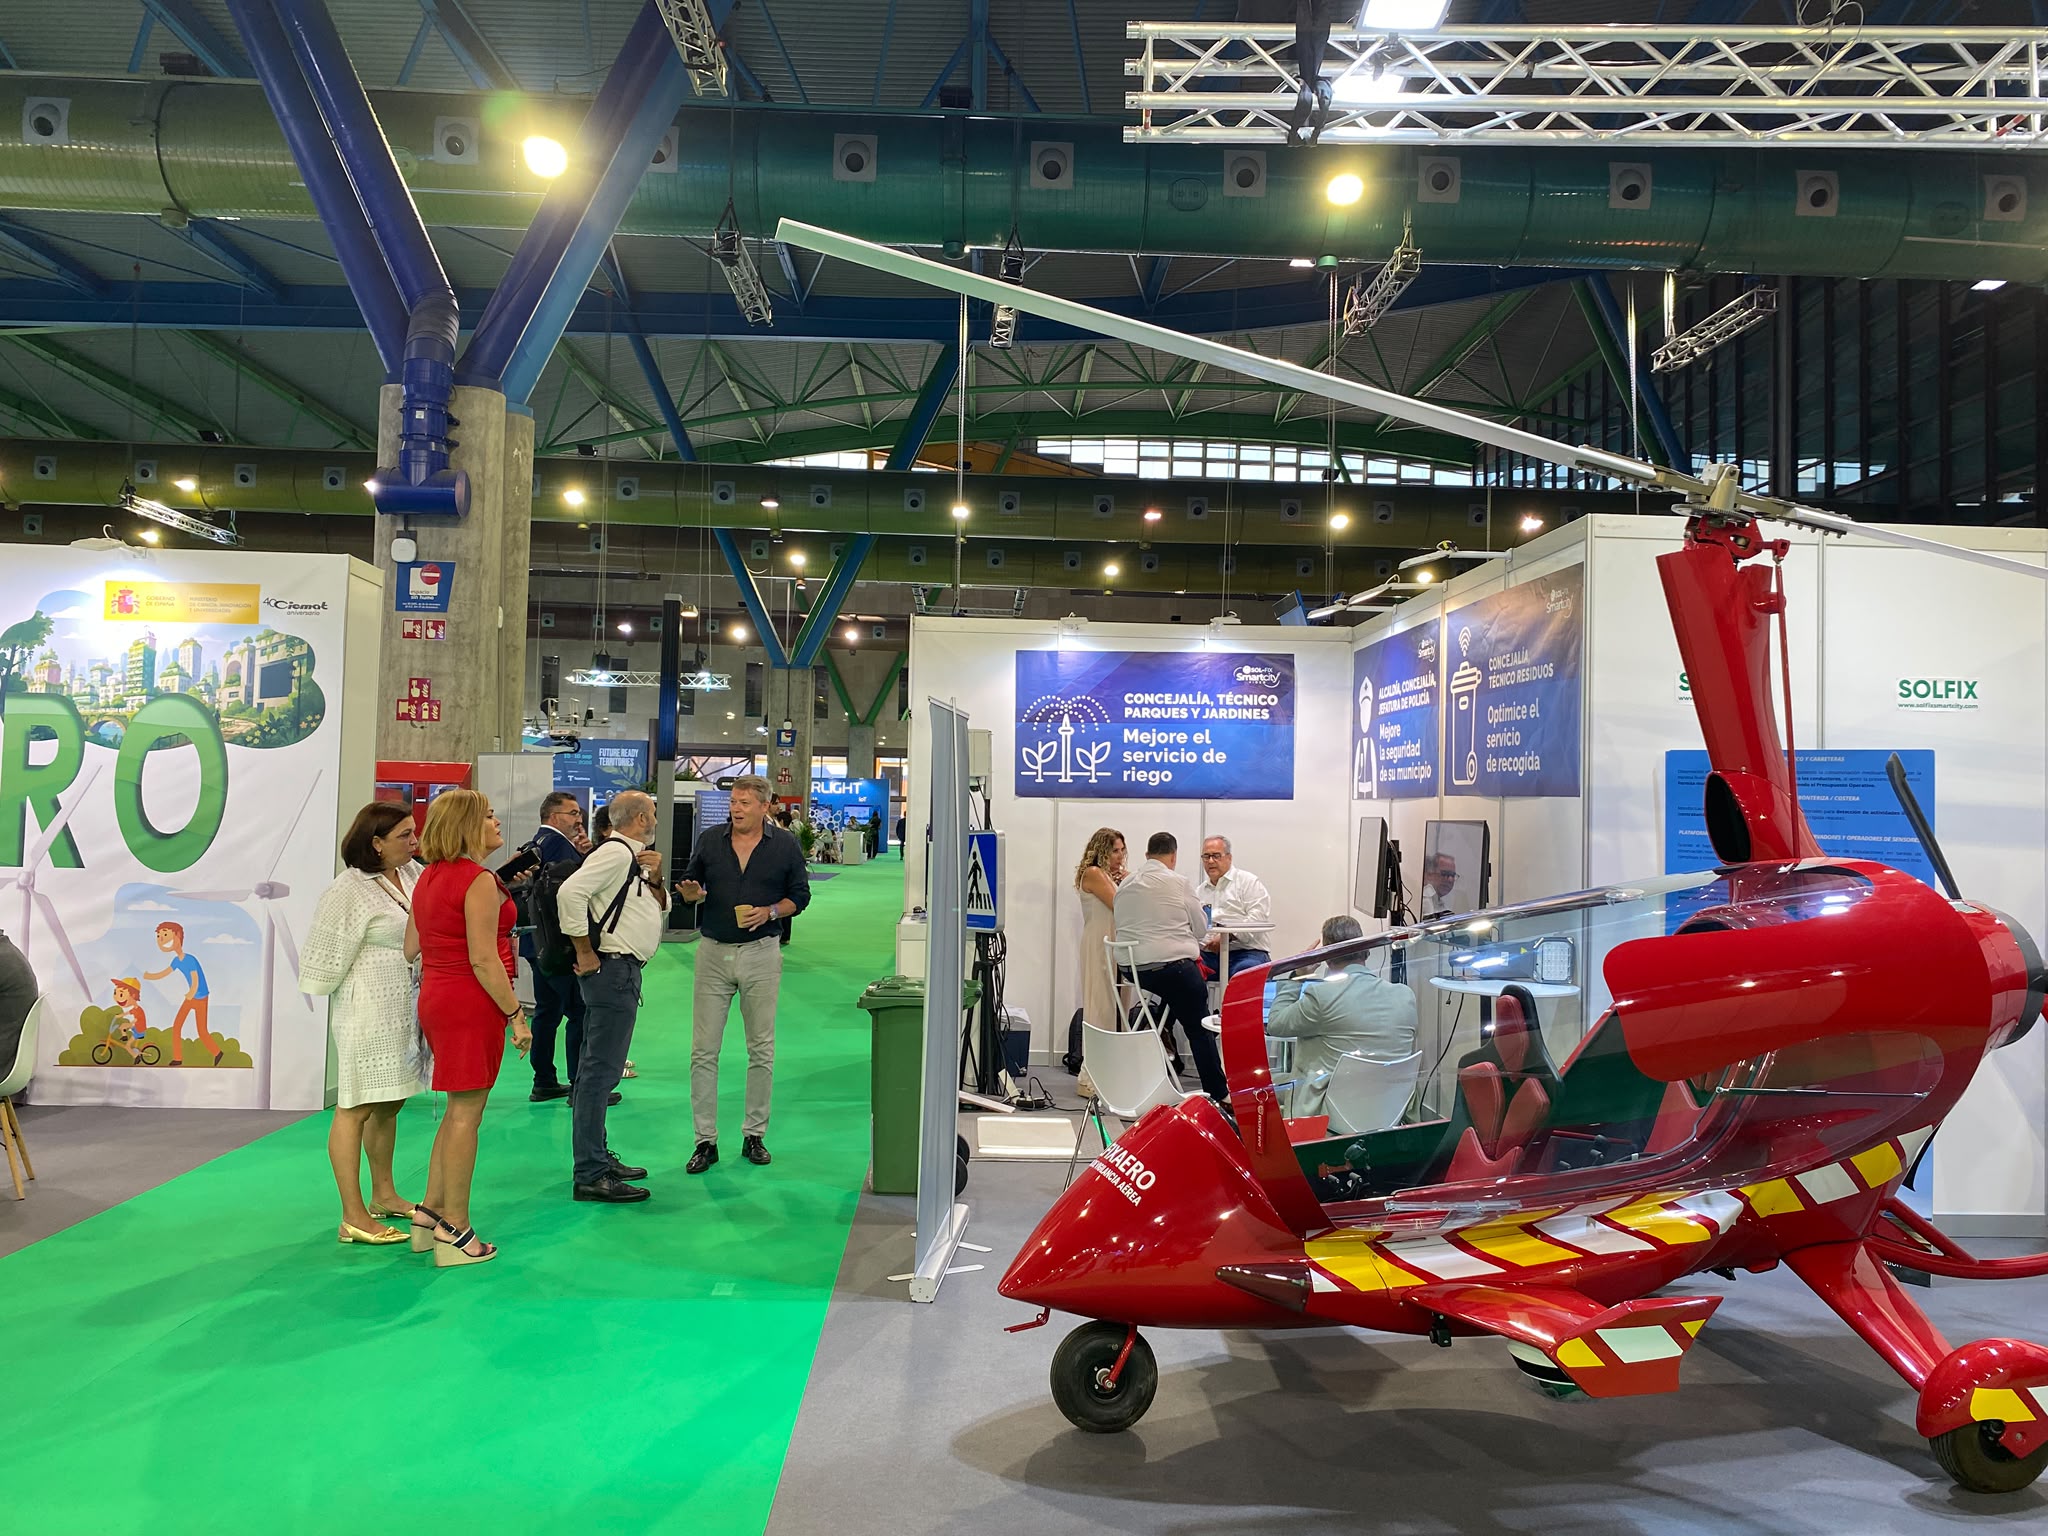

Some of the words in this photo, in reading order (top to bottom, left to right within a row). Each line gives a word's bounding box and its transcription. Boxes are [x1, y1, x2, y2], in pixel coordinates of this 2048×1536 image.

[1489, 671, 1516, 689] TÉCNICO
[1517, 662, 1554, 683] RESIDUOS
[1124, 691, 1214, 707] CONCEJALÍA,
[1217, 692, 1278, 706] TÉCNICO
[1401, 697, 1408, 710] DE
[1409, 688, 1430, 708] POLICÍA
[1898, 679, 1978, 699] SOLFIX
[1124, 707, 1188, 719] PARQUES
[1191, 708, 1201, 719] Y
[1202, 708, 1270, 720] JARDINES
[1487, 701, 1527, 729] Optimice
[1529, 697, 1540, 718] el
[1123, 728, 1188, 747] Mejore
[1193, 729, 1212, 744] el
[1380, 721, 1401, 743] Mejore
[1486, 726, 1521, 748] servicio
[598, 757, 635, 766] TERRITORIES
[599, 748, 620, 757] FUTURE
[620, 749, 639, 757] READY
[1122, 748, 1198, 763] servicio
[1202, 748, 1227, 763] de
[1380, 744, 1386, 761] la
[1386, 738, 1421, 764] seguridad
[1380, 765, 1388, 781] de
[1388, 768, 1396, 781] su
[1397, 760, 1432, 784] municipio
[1486, 754, 1497, 772] de
[1498, 750, 1541, 777] recogida
[1123, 766, 1173, 786] riego
[810, 781, 863, 795] RLIGHT
[1116, 1181, 1142, 1207] AÉREA
